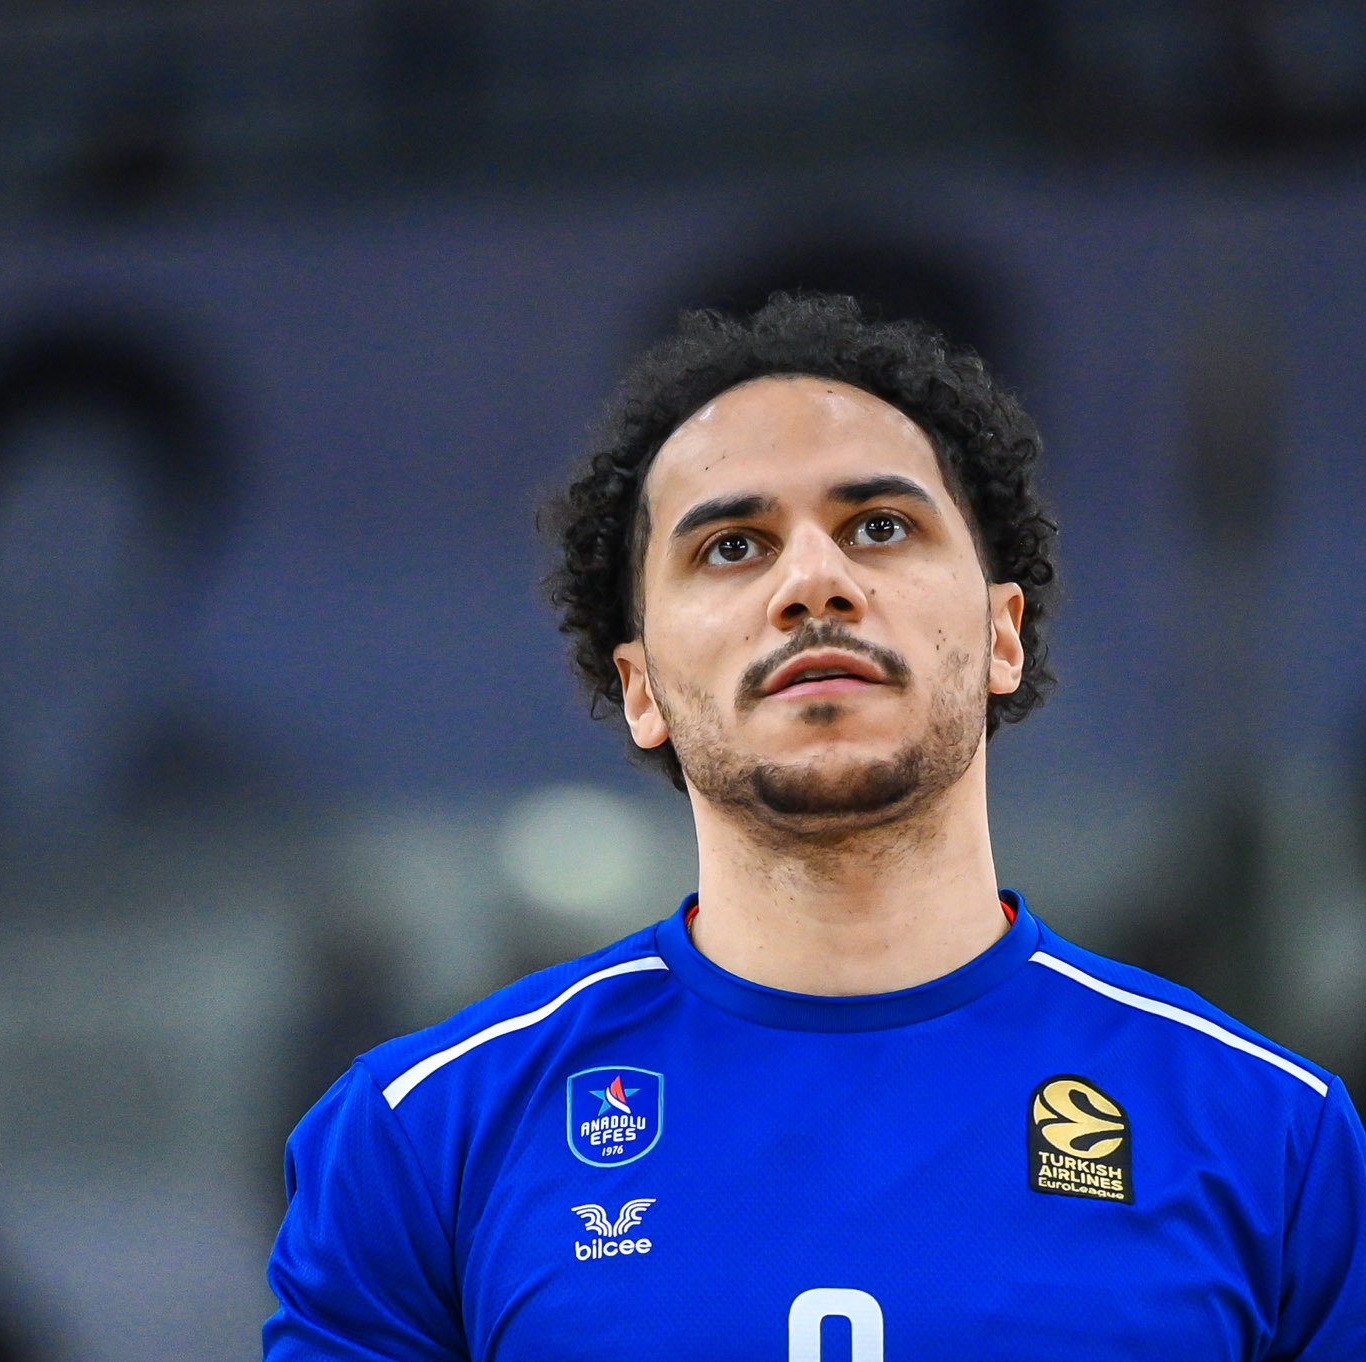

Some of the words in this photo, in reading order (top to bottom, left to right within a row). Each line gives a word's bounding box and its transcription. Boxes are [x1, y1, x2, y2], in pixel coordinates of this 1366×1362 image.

[581, 1115, 646, 1137] ANADOLU
[590, 1127, 636, 1146] EFES
[601, 1145, 624, 1157] 1976
[1038, 1151, 1123, 1179] TURKISH
[1038, 1165, 1124, 1191] AIRLINES
[575, 1238, 652, 1261] bilcee
